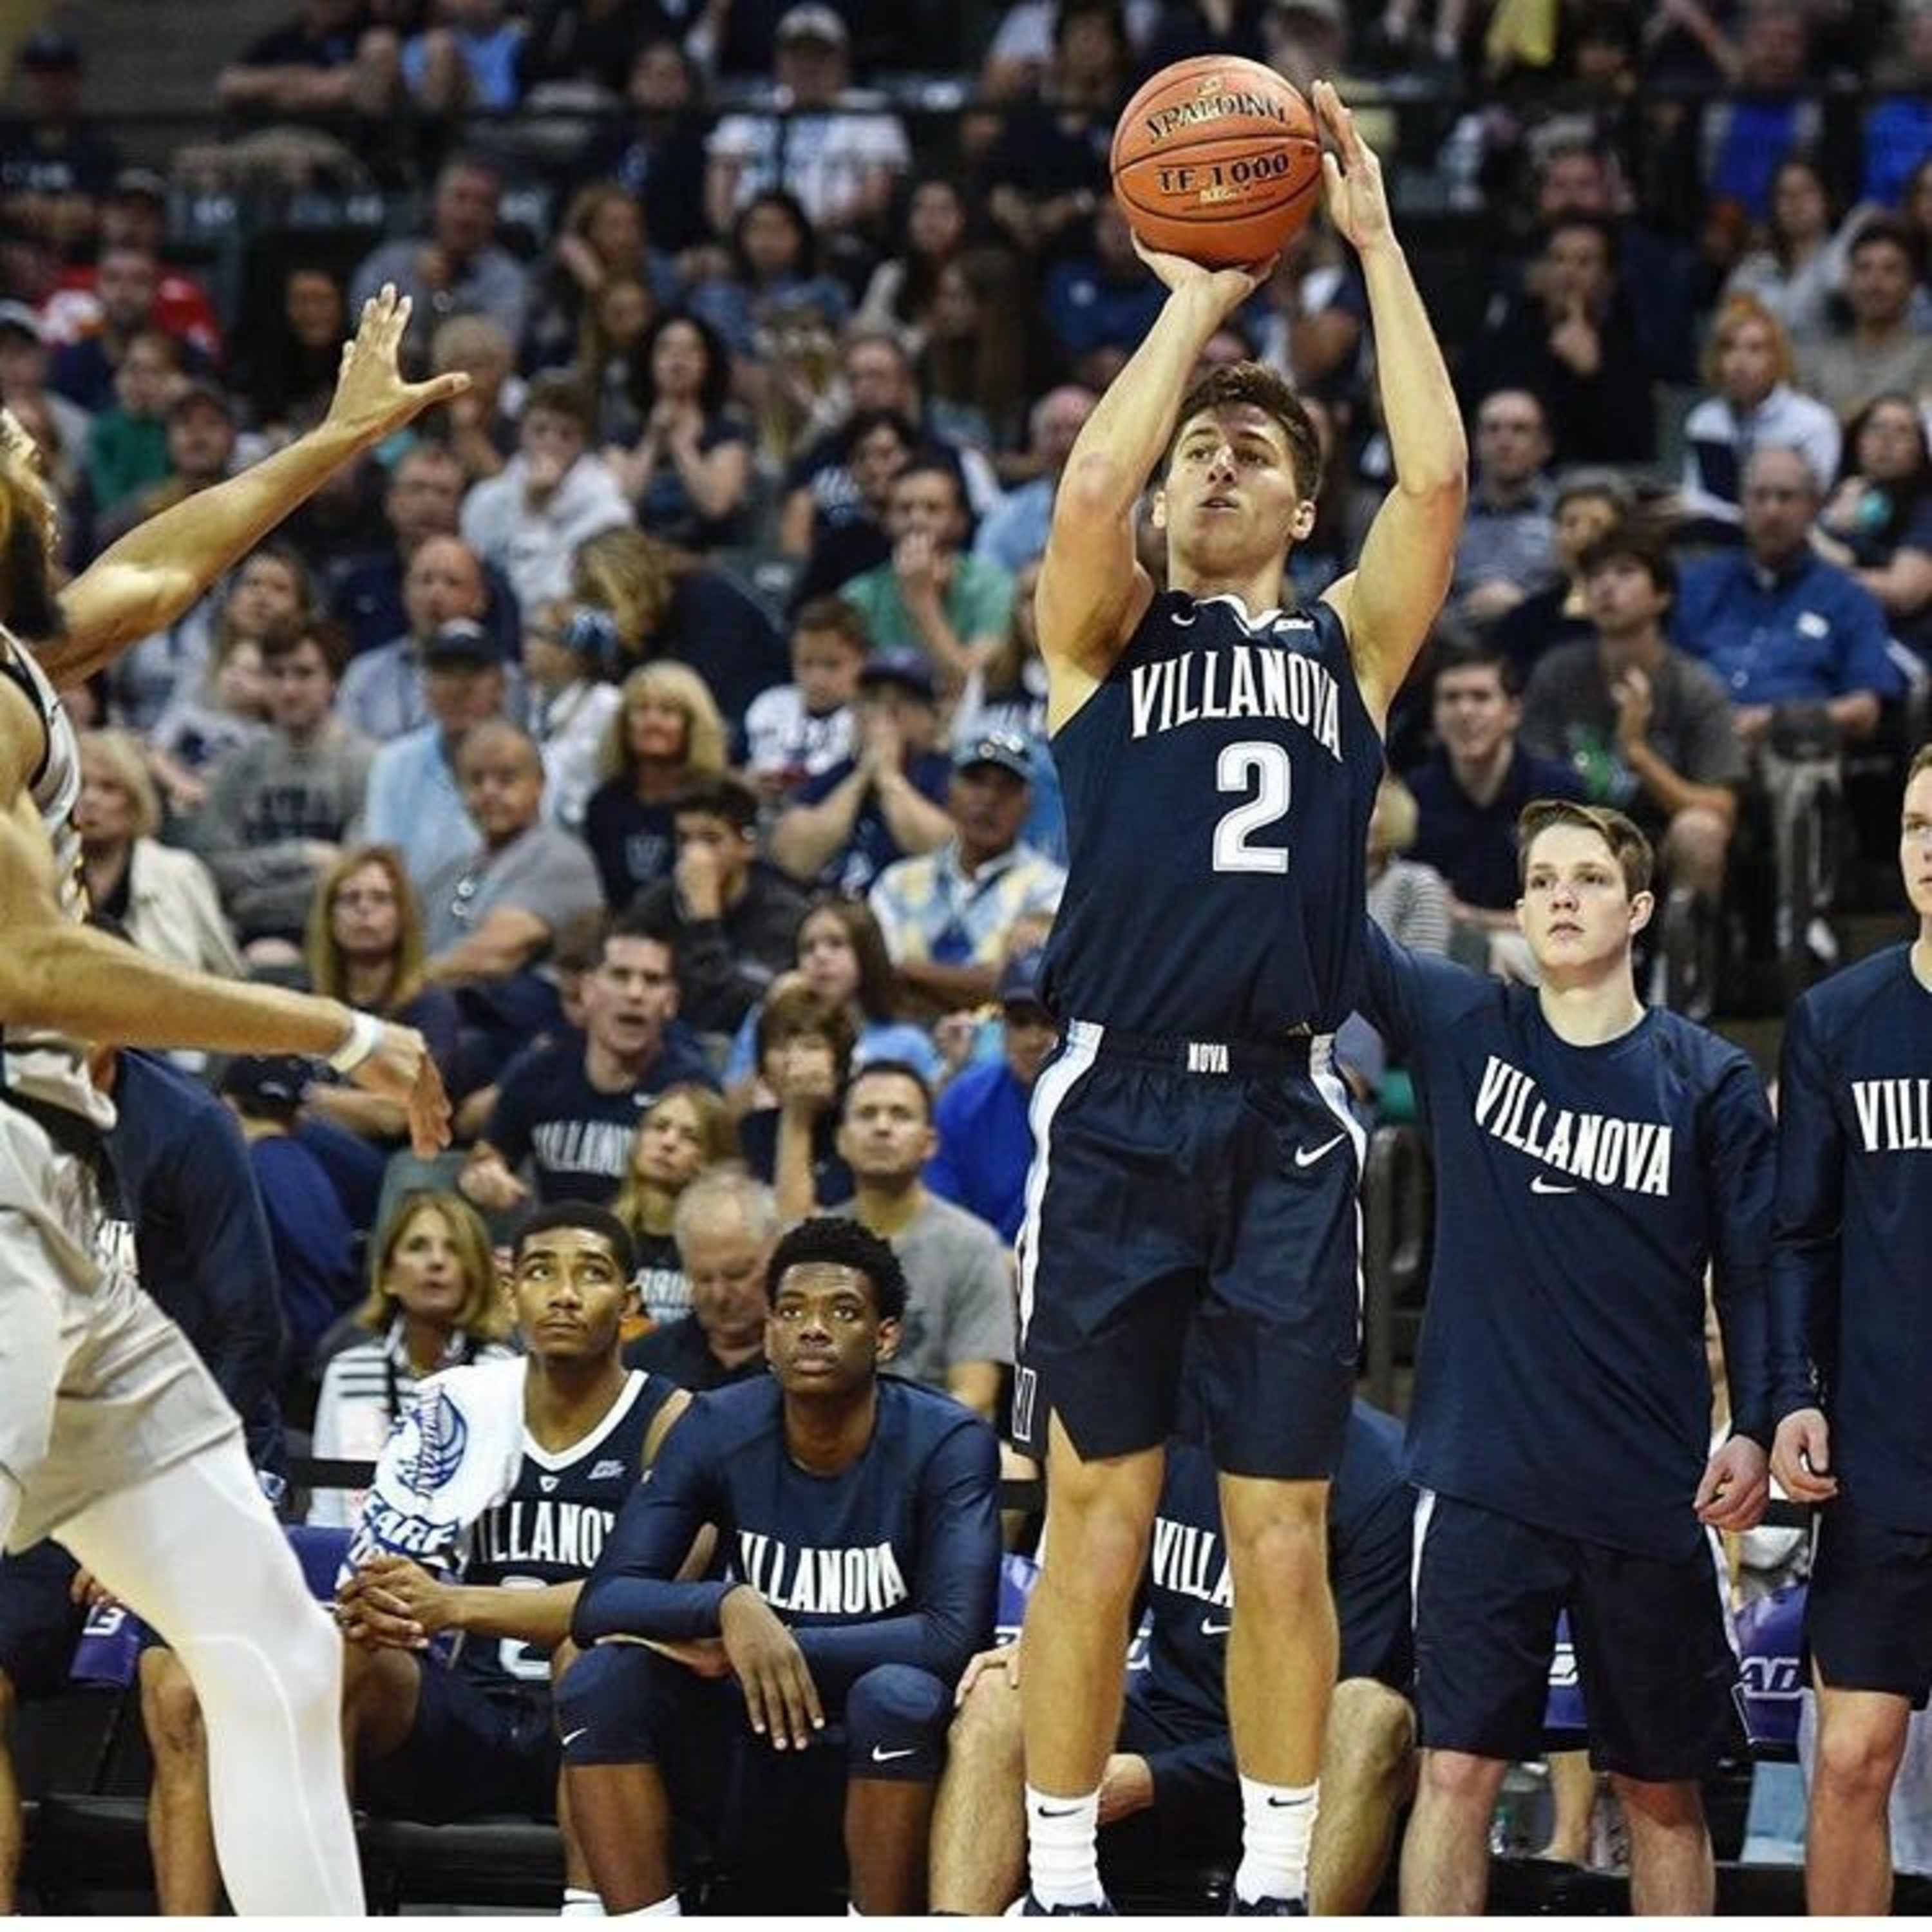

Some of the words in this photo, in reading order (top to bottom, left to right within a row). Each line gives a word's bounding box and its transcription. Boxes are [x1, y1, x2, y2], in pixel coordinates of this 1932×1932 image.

[1146, 92, 1291, 144] SPALDING
[1213, 153, 1289, 187] 1000
[1130, 645, 1343, 763] VILLANOVA
[1212, 741, 1291, 874] 2
[1187, 1042, 1229, 1073] NOVA
[1474, 1054, 1672, 1197] VILLANOVA
[736, 1529, 909, 1614] ILLANOVA
